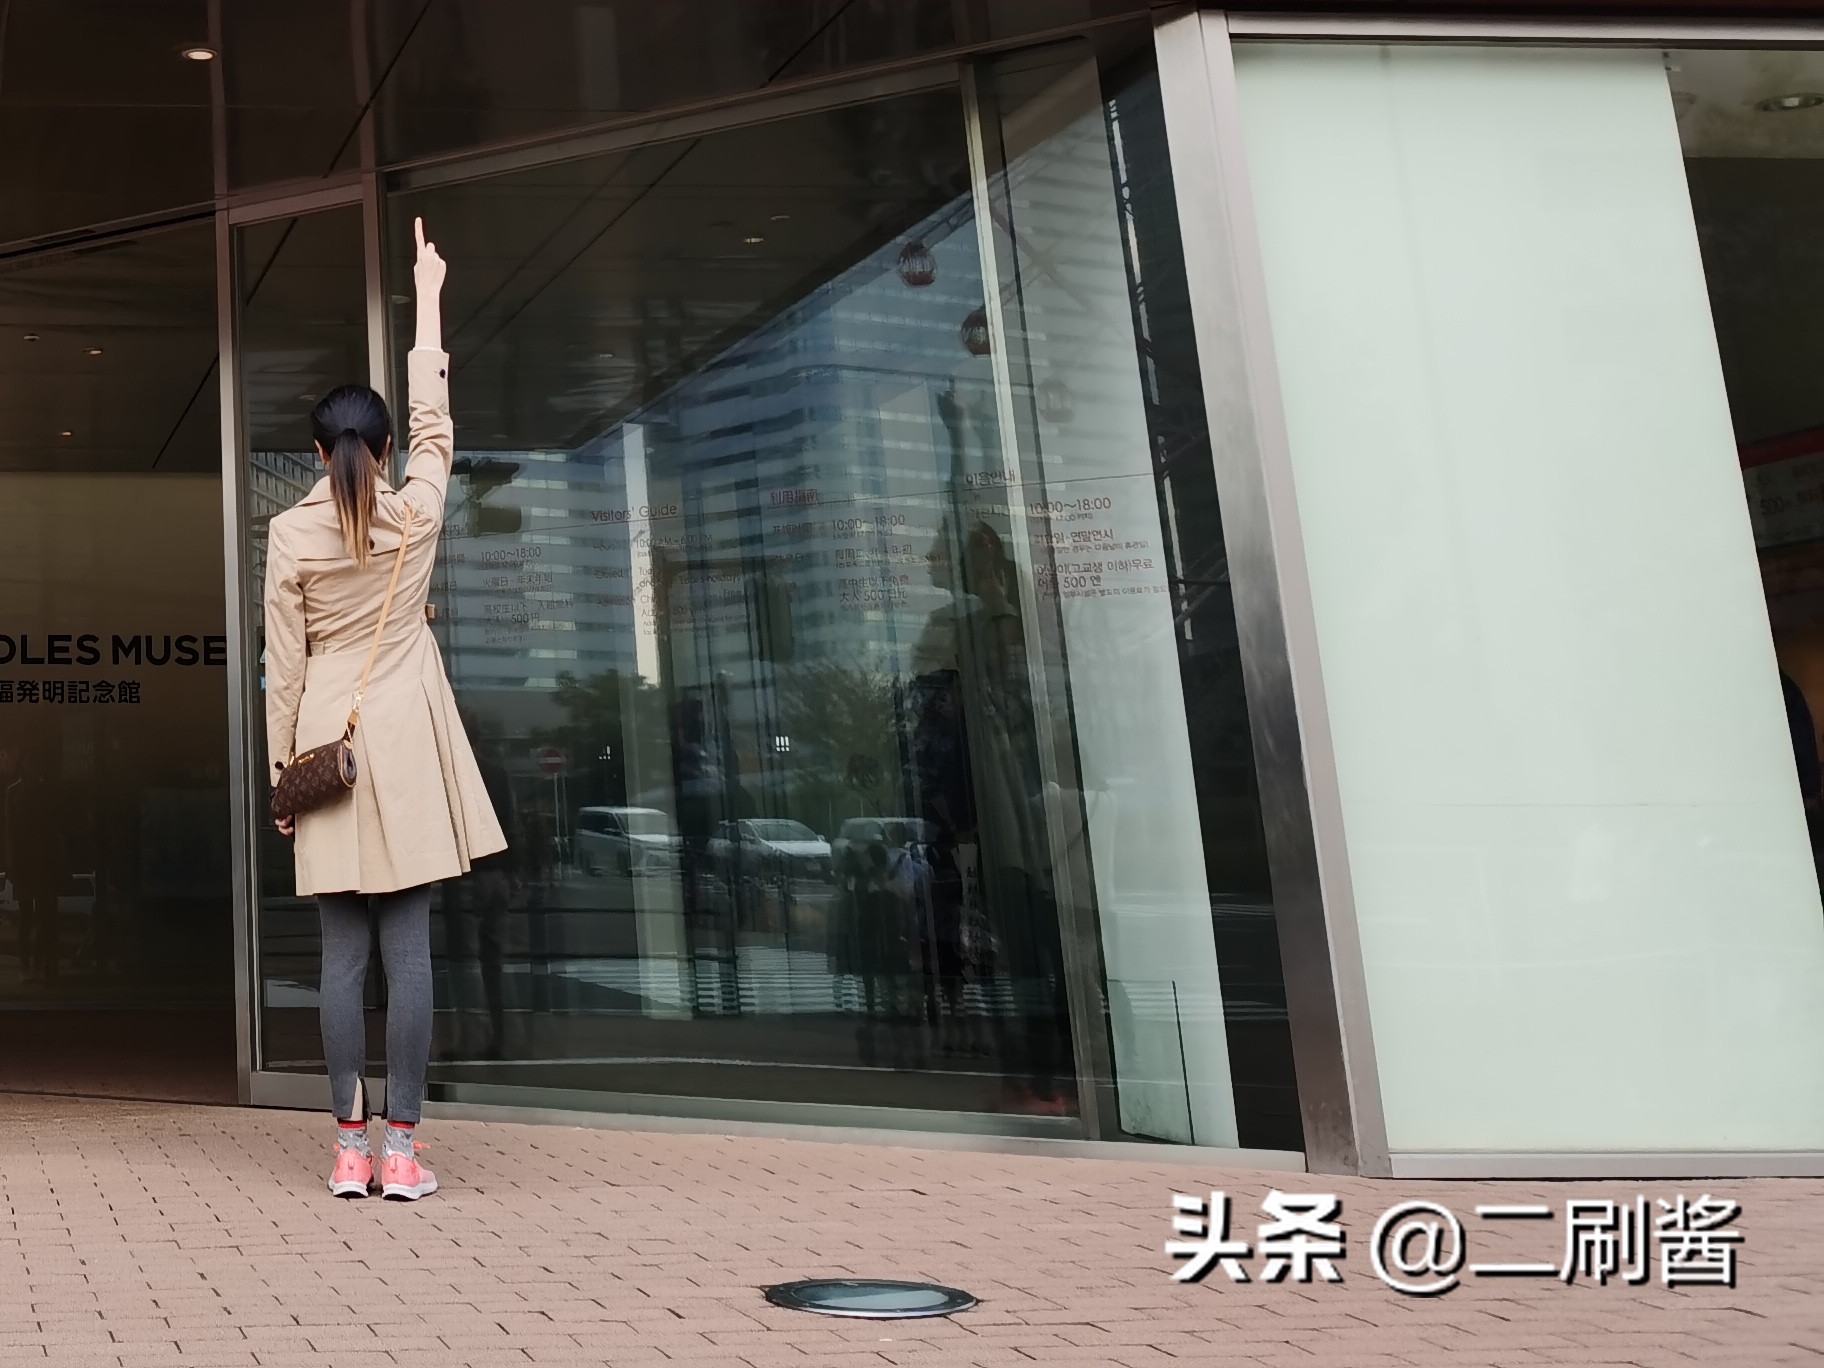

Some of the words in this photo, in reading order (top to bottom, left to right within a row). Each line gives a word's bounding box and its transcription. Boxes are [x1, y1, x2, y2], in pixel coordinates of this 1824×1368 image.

[591, 507, 635, 522] Visitors'
[639, 504, 677, 518] Guide
[1063, 575, 1087, 589] 500
